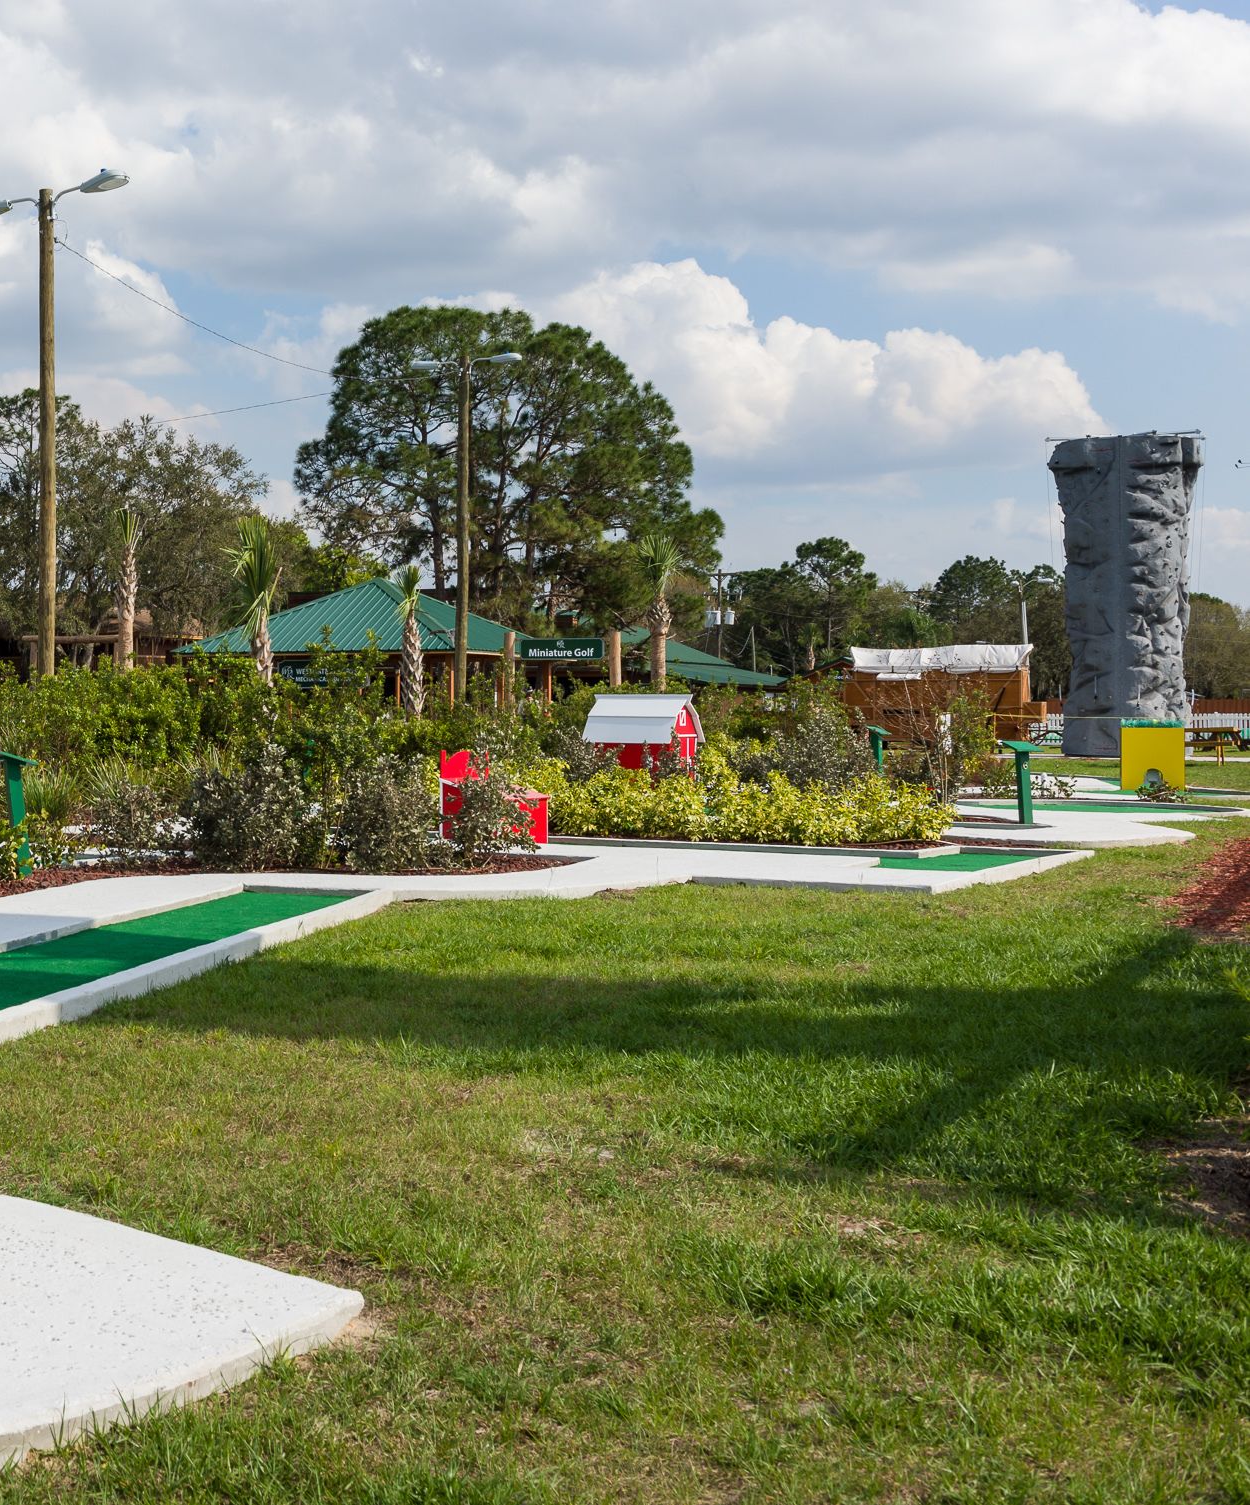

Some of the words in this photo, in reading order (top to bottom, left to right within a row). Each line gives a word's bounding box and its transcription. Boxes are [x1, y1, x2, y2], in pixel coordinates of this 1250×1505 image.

[529, 648, 572, 657] Miniature
[574, 647, 594, 657] Golf
[1022, 761, 1028, 770] 6
